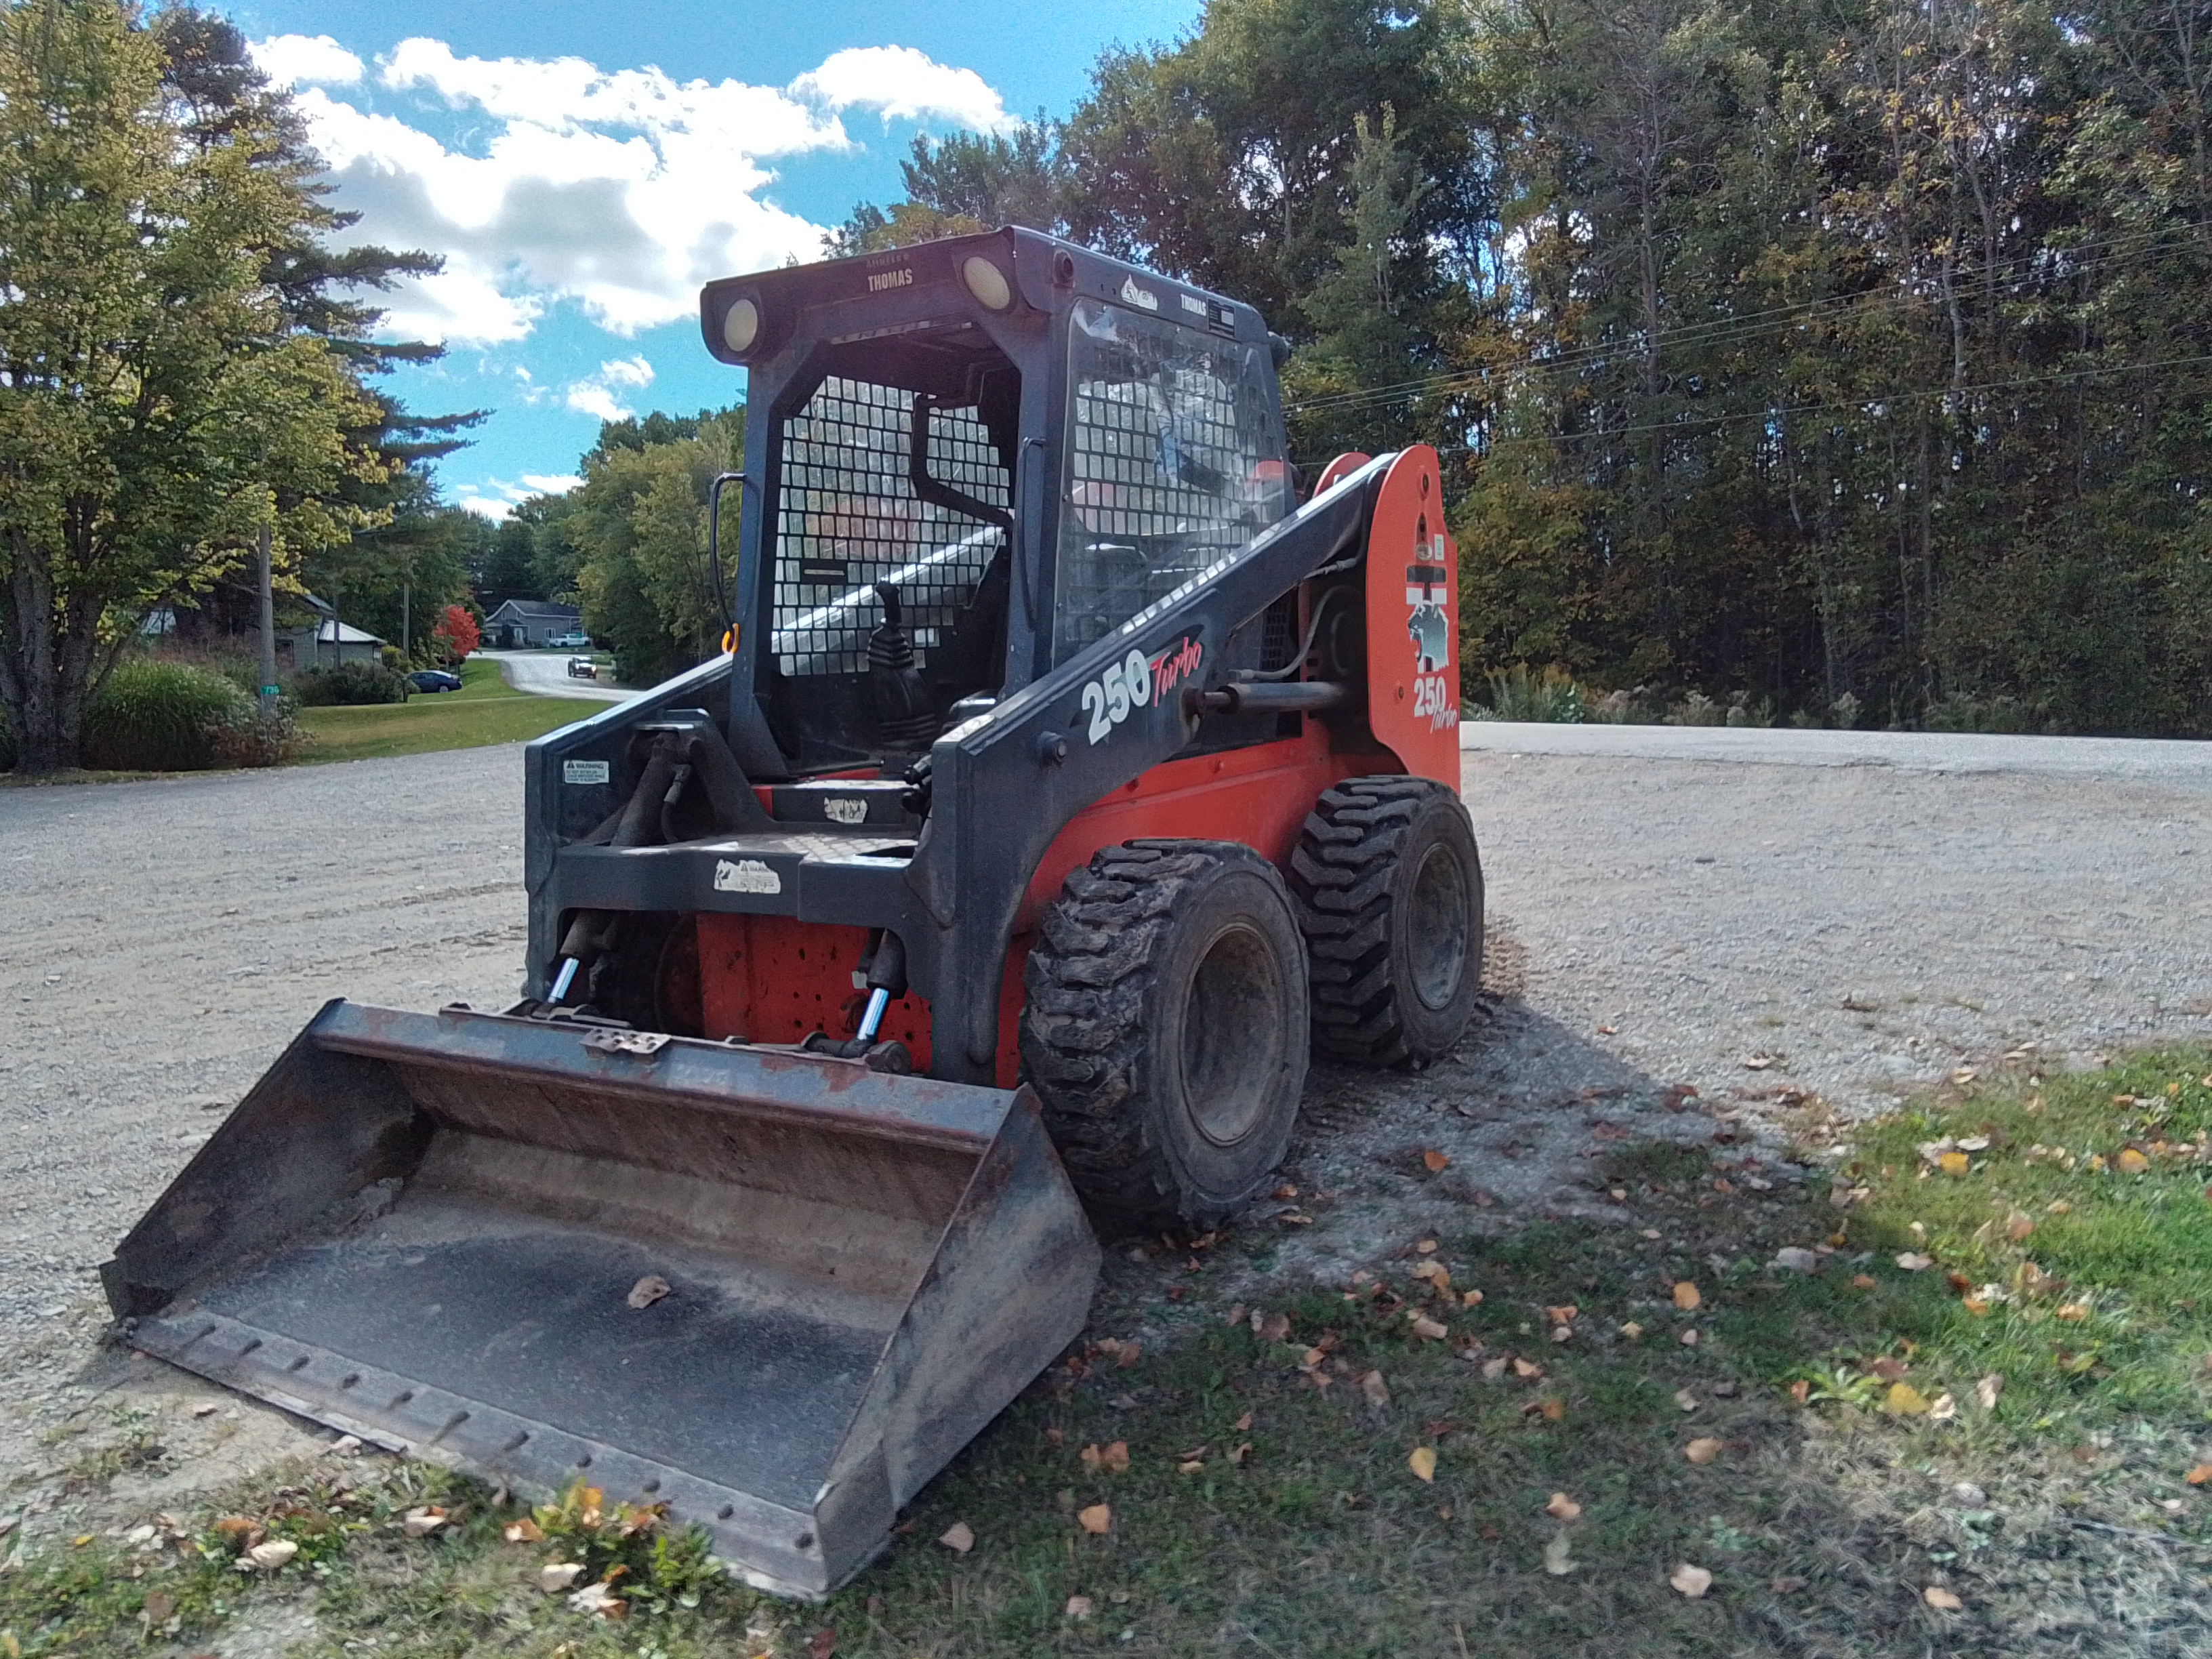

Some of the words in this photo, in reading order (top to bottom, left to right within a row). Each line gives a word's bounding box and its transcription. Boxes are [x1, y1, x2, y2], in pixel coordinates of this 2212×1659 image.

[868, 268, 913, 291] THOMAS
[1181, 293, 1206, 316] THOMAS
[1082, 649, 1151, 745] 250
[1150, 637, 1202, 707] Turbo
[1413, 676, 1446, 717] 250
[1430, 701, 1457, 734] Turbo
